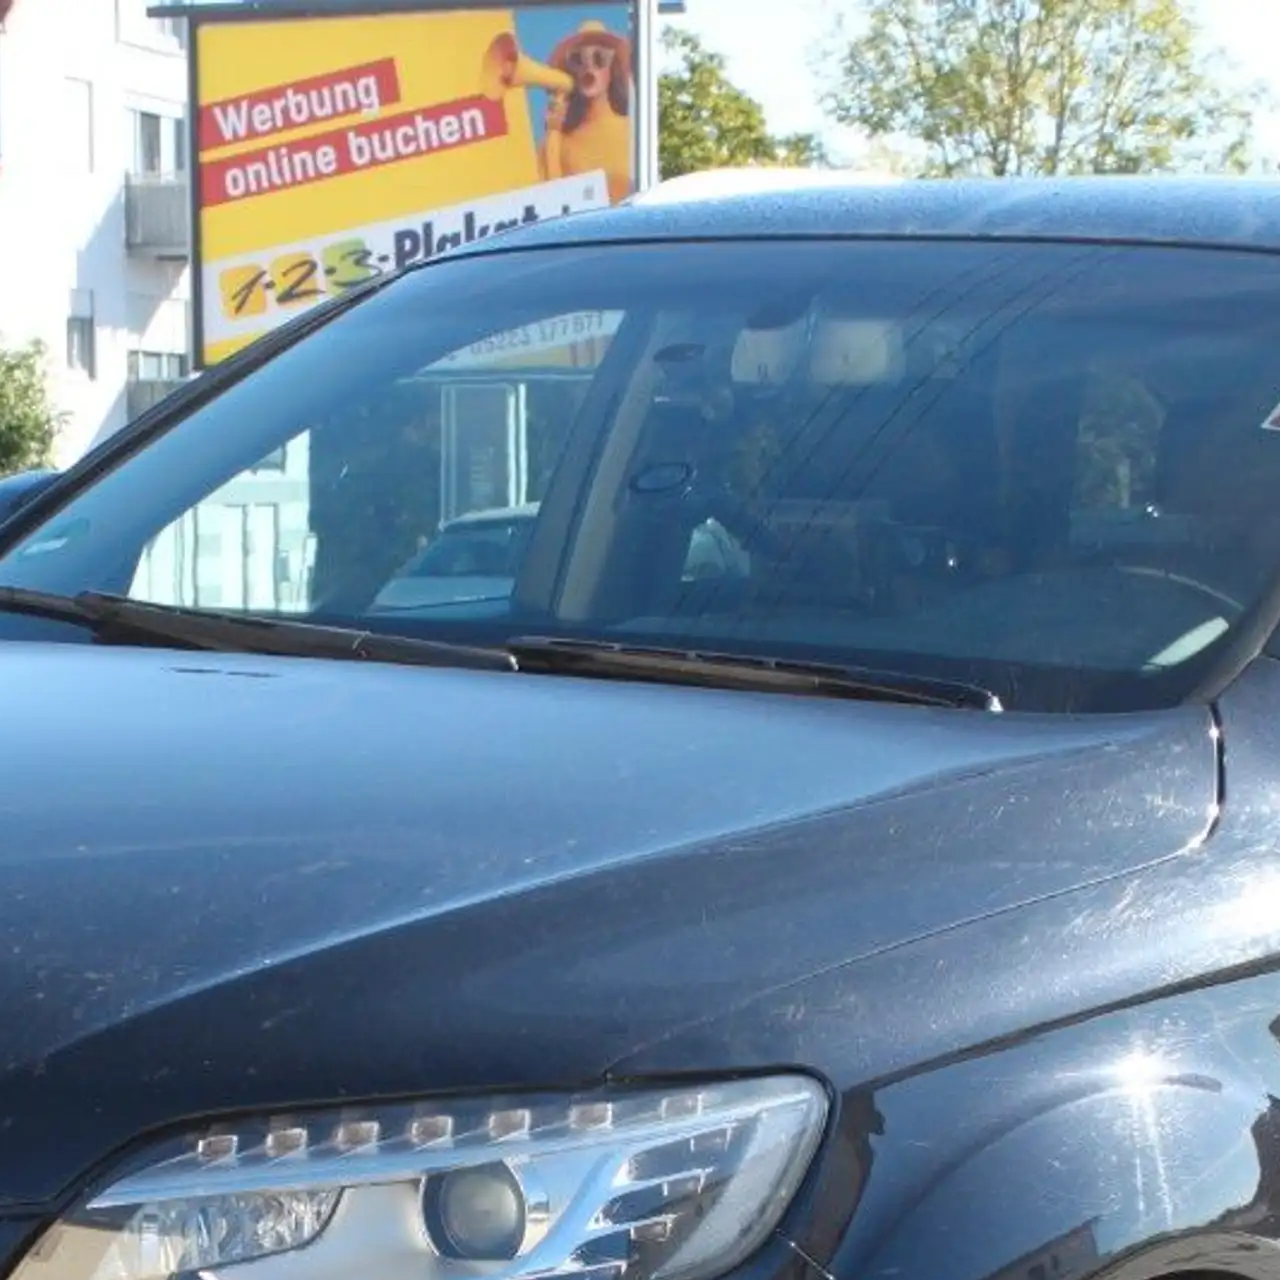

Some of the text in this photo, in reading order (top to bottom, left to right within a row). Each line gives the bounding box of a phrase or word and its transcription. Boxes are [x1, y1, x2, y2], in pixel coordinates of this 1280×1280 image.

[213, 75, 381, 142] Werbung
[225, 106, 487, 197] online buchen
